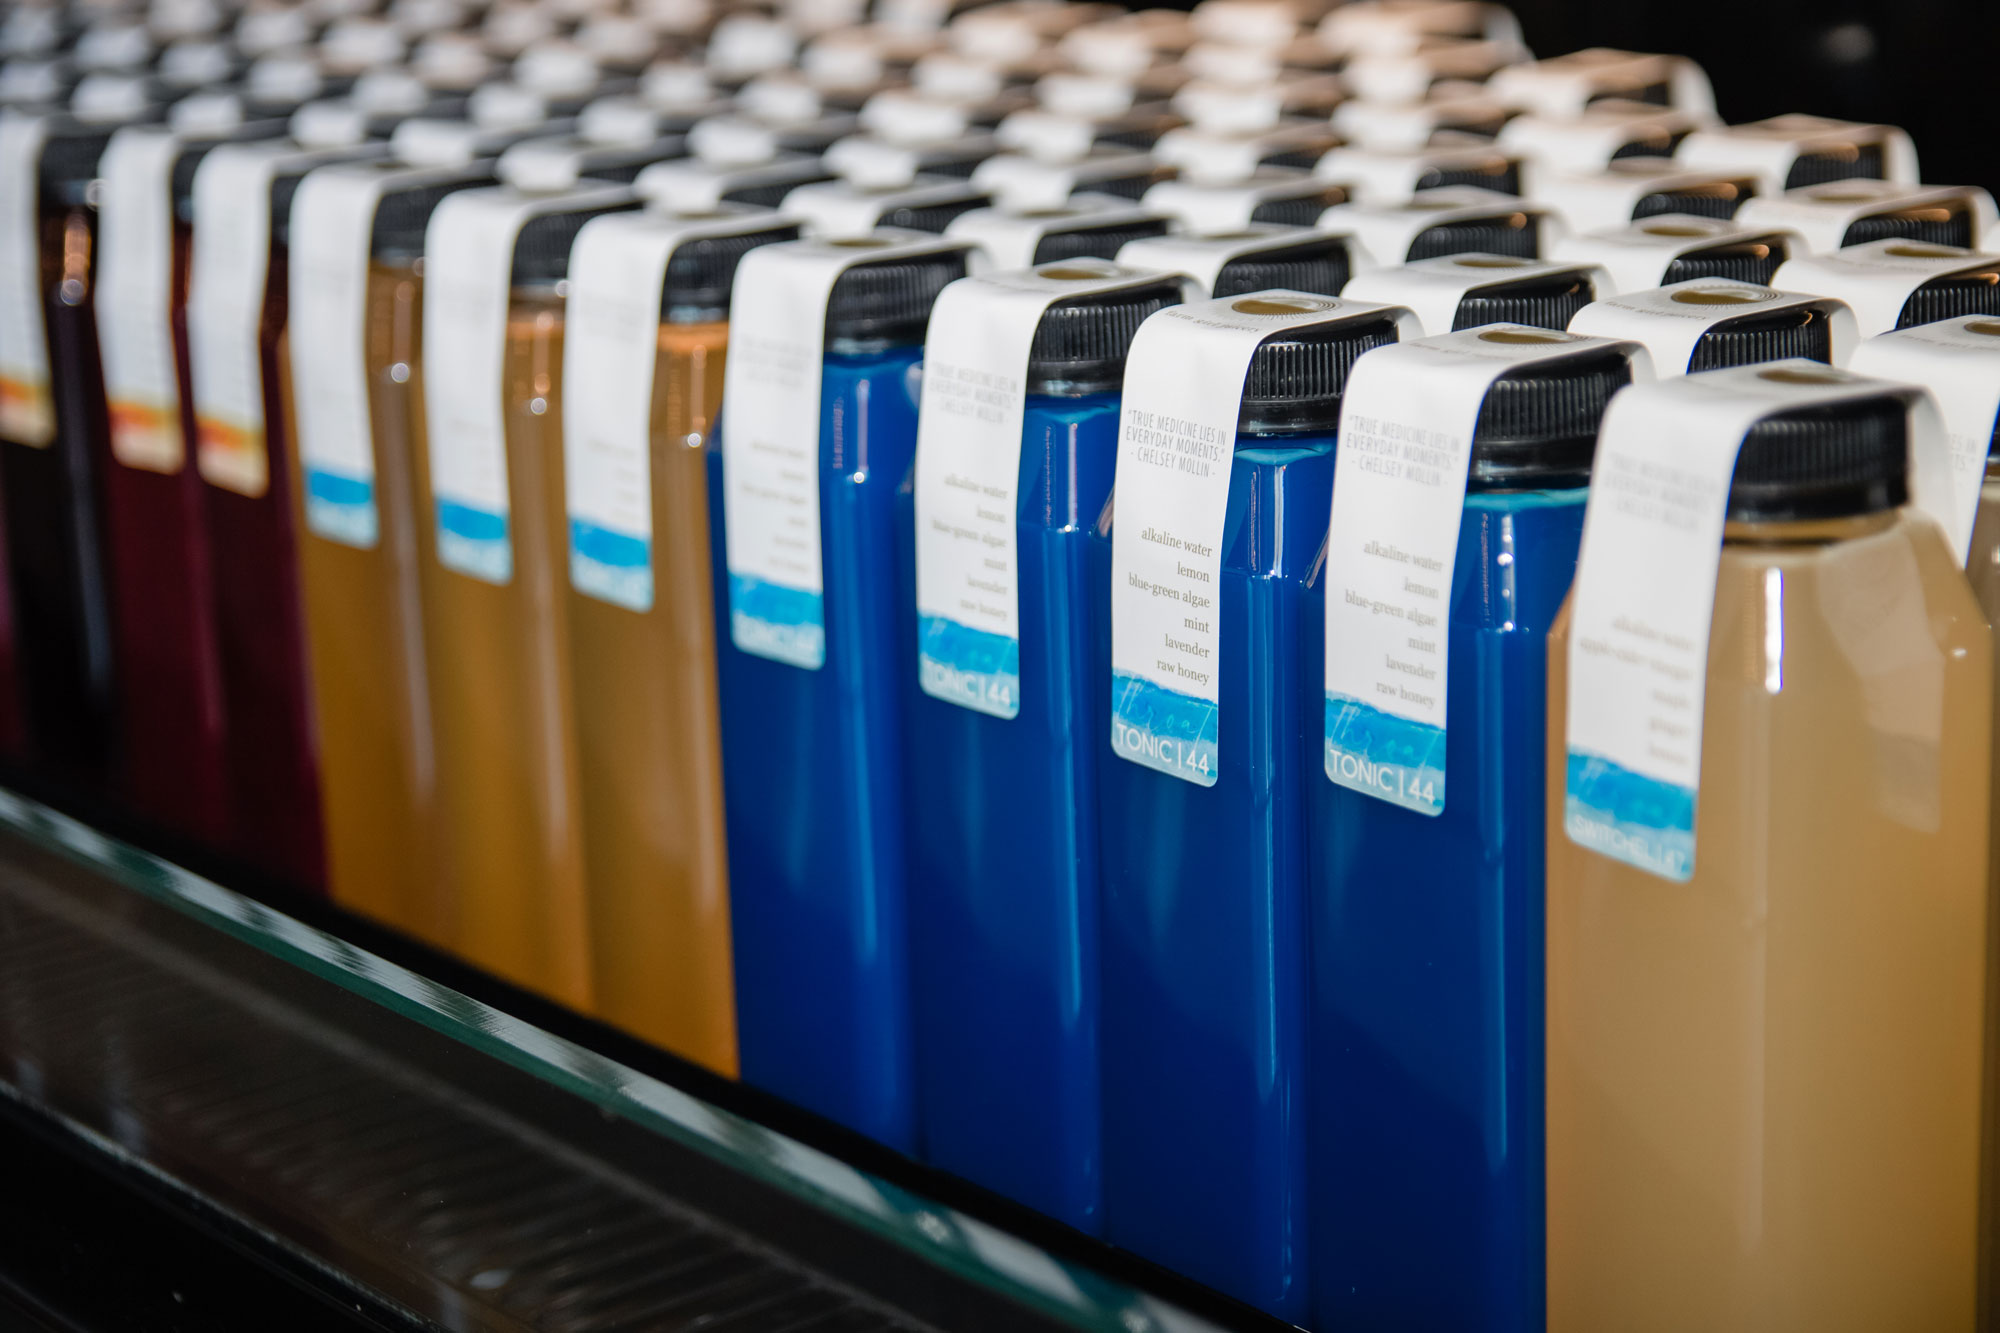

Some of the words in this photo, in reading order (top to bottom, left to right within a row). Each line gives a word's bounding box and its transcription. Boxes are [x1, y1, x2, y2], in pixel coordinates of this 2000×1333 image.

[1165, 309, 1194, 322] farm
[1126, 425, 1174, 450] EVERYDAY
[1128, 408, 1154, 428] "TRUE
[1156, 415, 1197, 439] MEDICINE
[1199, 424, 1216, 443] LIES
[1218, 430, 1227, 446] IN
[1381, 421, 1427, 447] MEDICINE
[1429, 432, 1448, 451] LIES
[1450, 437, 1462, 454] IN
[1346, 432, 1399, 457] EVERYDAY
[1137, 446, 1177, 469] CHELSEY
[1178, 456, 1210, 478] MOLLIN
[1359, 453, 1402, 478] CHELSEY
[1405, 465, 1442, 488] MOLLIN
[1141, 527, 1182, 549] alkaline
[1183, 539, 1213, 558] water
[1363, 540, 1410, 565] alkaline
[1412, 553, 1443, 573] water
[1177, 561, 1210, 584] lemon
[1404, 576, 1440, 600] lemon
[1128, 572, 1180, 600] blue-green
[1182, 585, 1210, 609] algae
[1345, 588, 1404, 619] blue-green
[1407, 607, 1437, 629] algae
[1184, 616, 1210, 634] mint
[1165, 633, 1210, 659] lavender
[1407, 634, 1436, 654] mint
[1157, 659, 1175, 674] raw
[1177, 660, 1210, 687] honey
[1386, 653, 1437, 681] lavender
[1375, 680, 1397, 698] raw
[1399, 681, 1436, 711] honey
[1116, 723, 1173, 763] TONIC
[1186, 749, 1210, 776] 44
[1330, 748, 1393, 792] TONIC
[1409, 779, 1436, 805] 44
